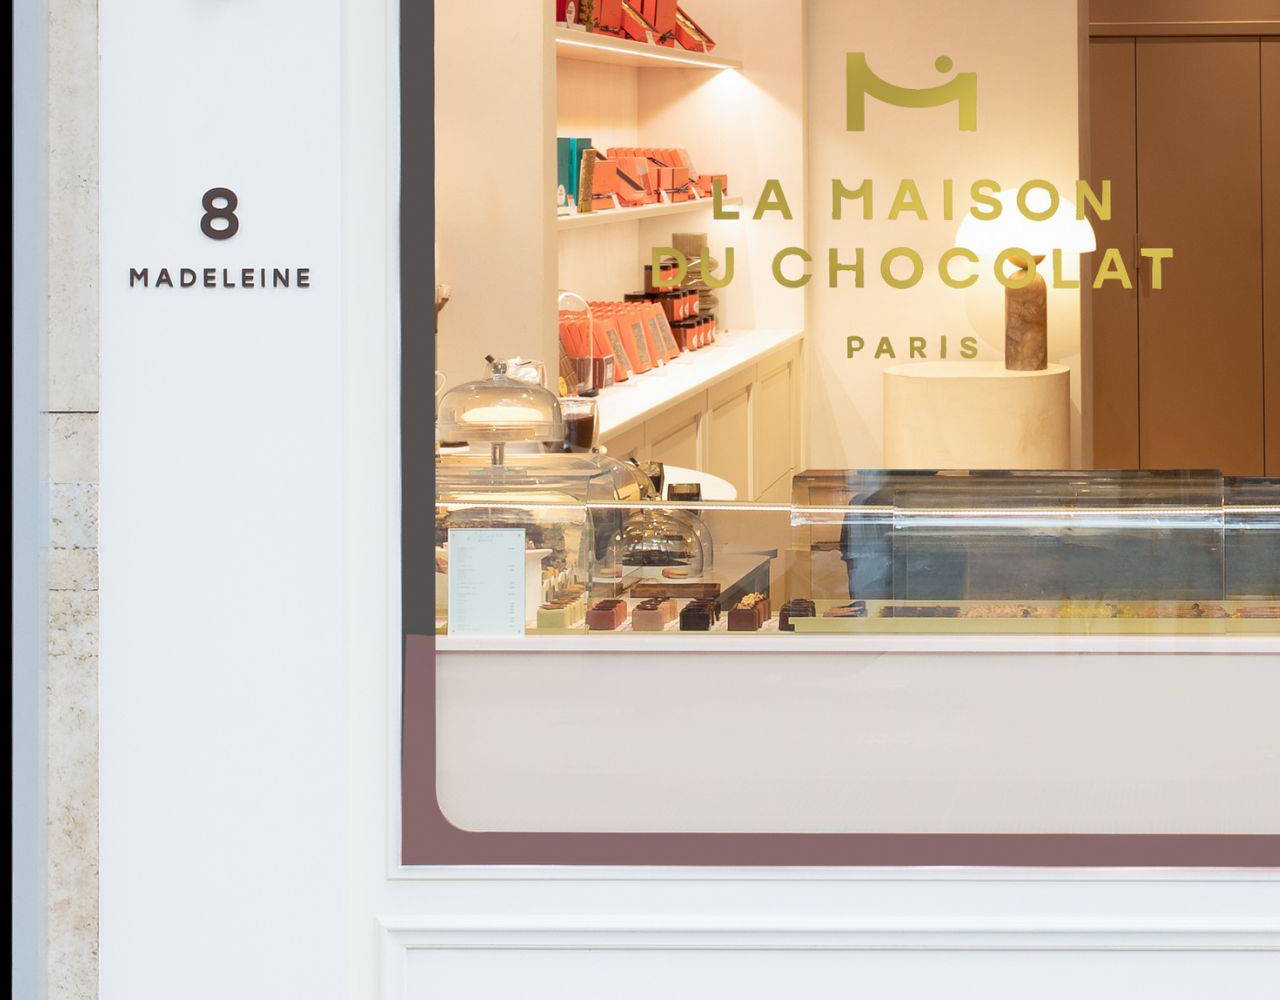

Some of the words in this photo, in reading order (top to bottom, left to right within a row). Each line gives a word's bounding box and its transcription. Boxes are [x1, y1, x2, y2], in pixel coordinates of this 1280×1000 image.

[199, 187, 240, 241] 8
[711, 178, 793, 222] LA
[831, 178, 1112, 222] MAISON
[129, 267, 311, 289] MADELEINE
[650, 246, 736, 290] DU
[771, 246, 1174, 291] CHOCOLAT
[846, 335, 979, 359] PARIS
